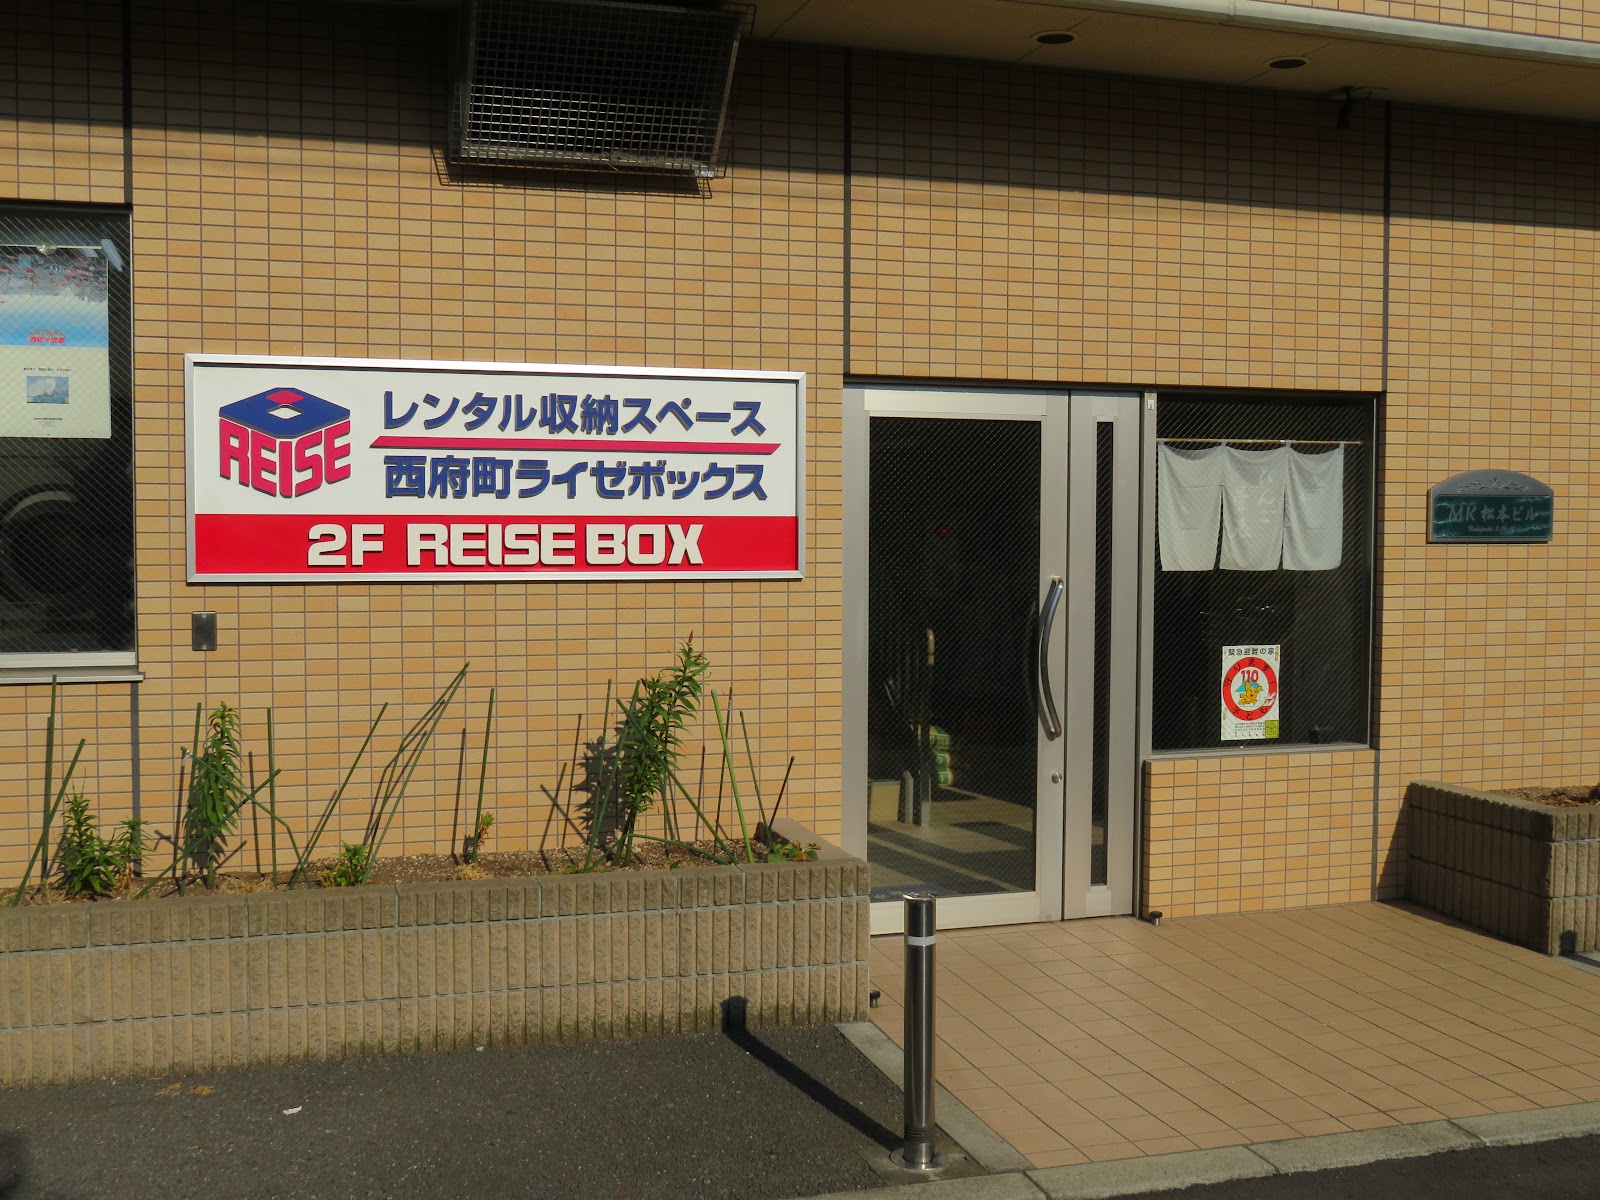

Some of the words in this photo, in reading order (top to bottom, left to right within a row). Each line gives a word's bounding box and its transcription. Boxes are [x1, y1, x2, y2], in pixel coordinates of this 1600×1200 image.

[383, 391, 766, 437] レンタル収納スペース
[219, 420, 351, 499] REISE
[385, 455, 768, 501] 西府町ライゼボックス
[1450, 505, 1476, 522] MK
[307, 523, 384, 567] 2F
[406, 523, 577, 566] REISE
[586, 523, 704, 566] BOX
[1228, 648, 1275, 656] 緊急避難の家
[1241, 669, 1259, 683] 110
